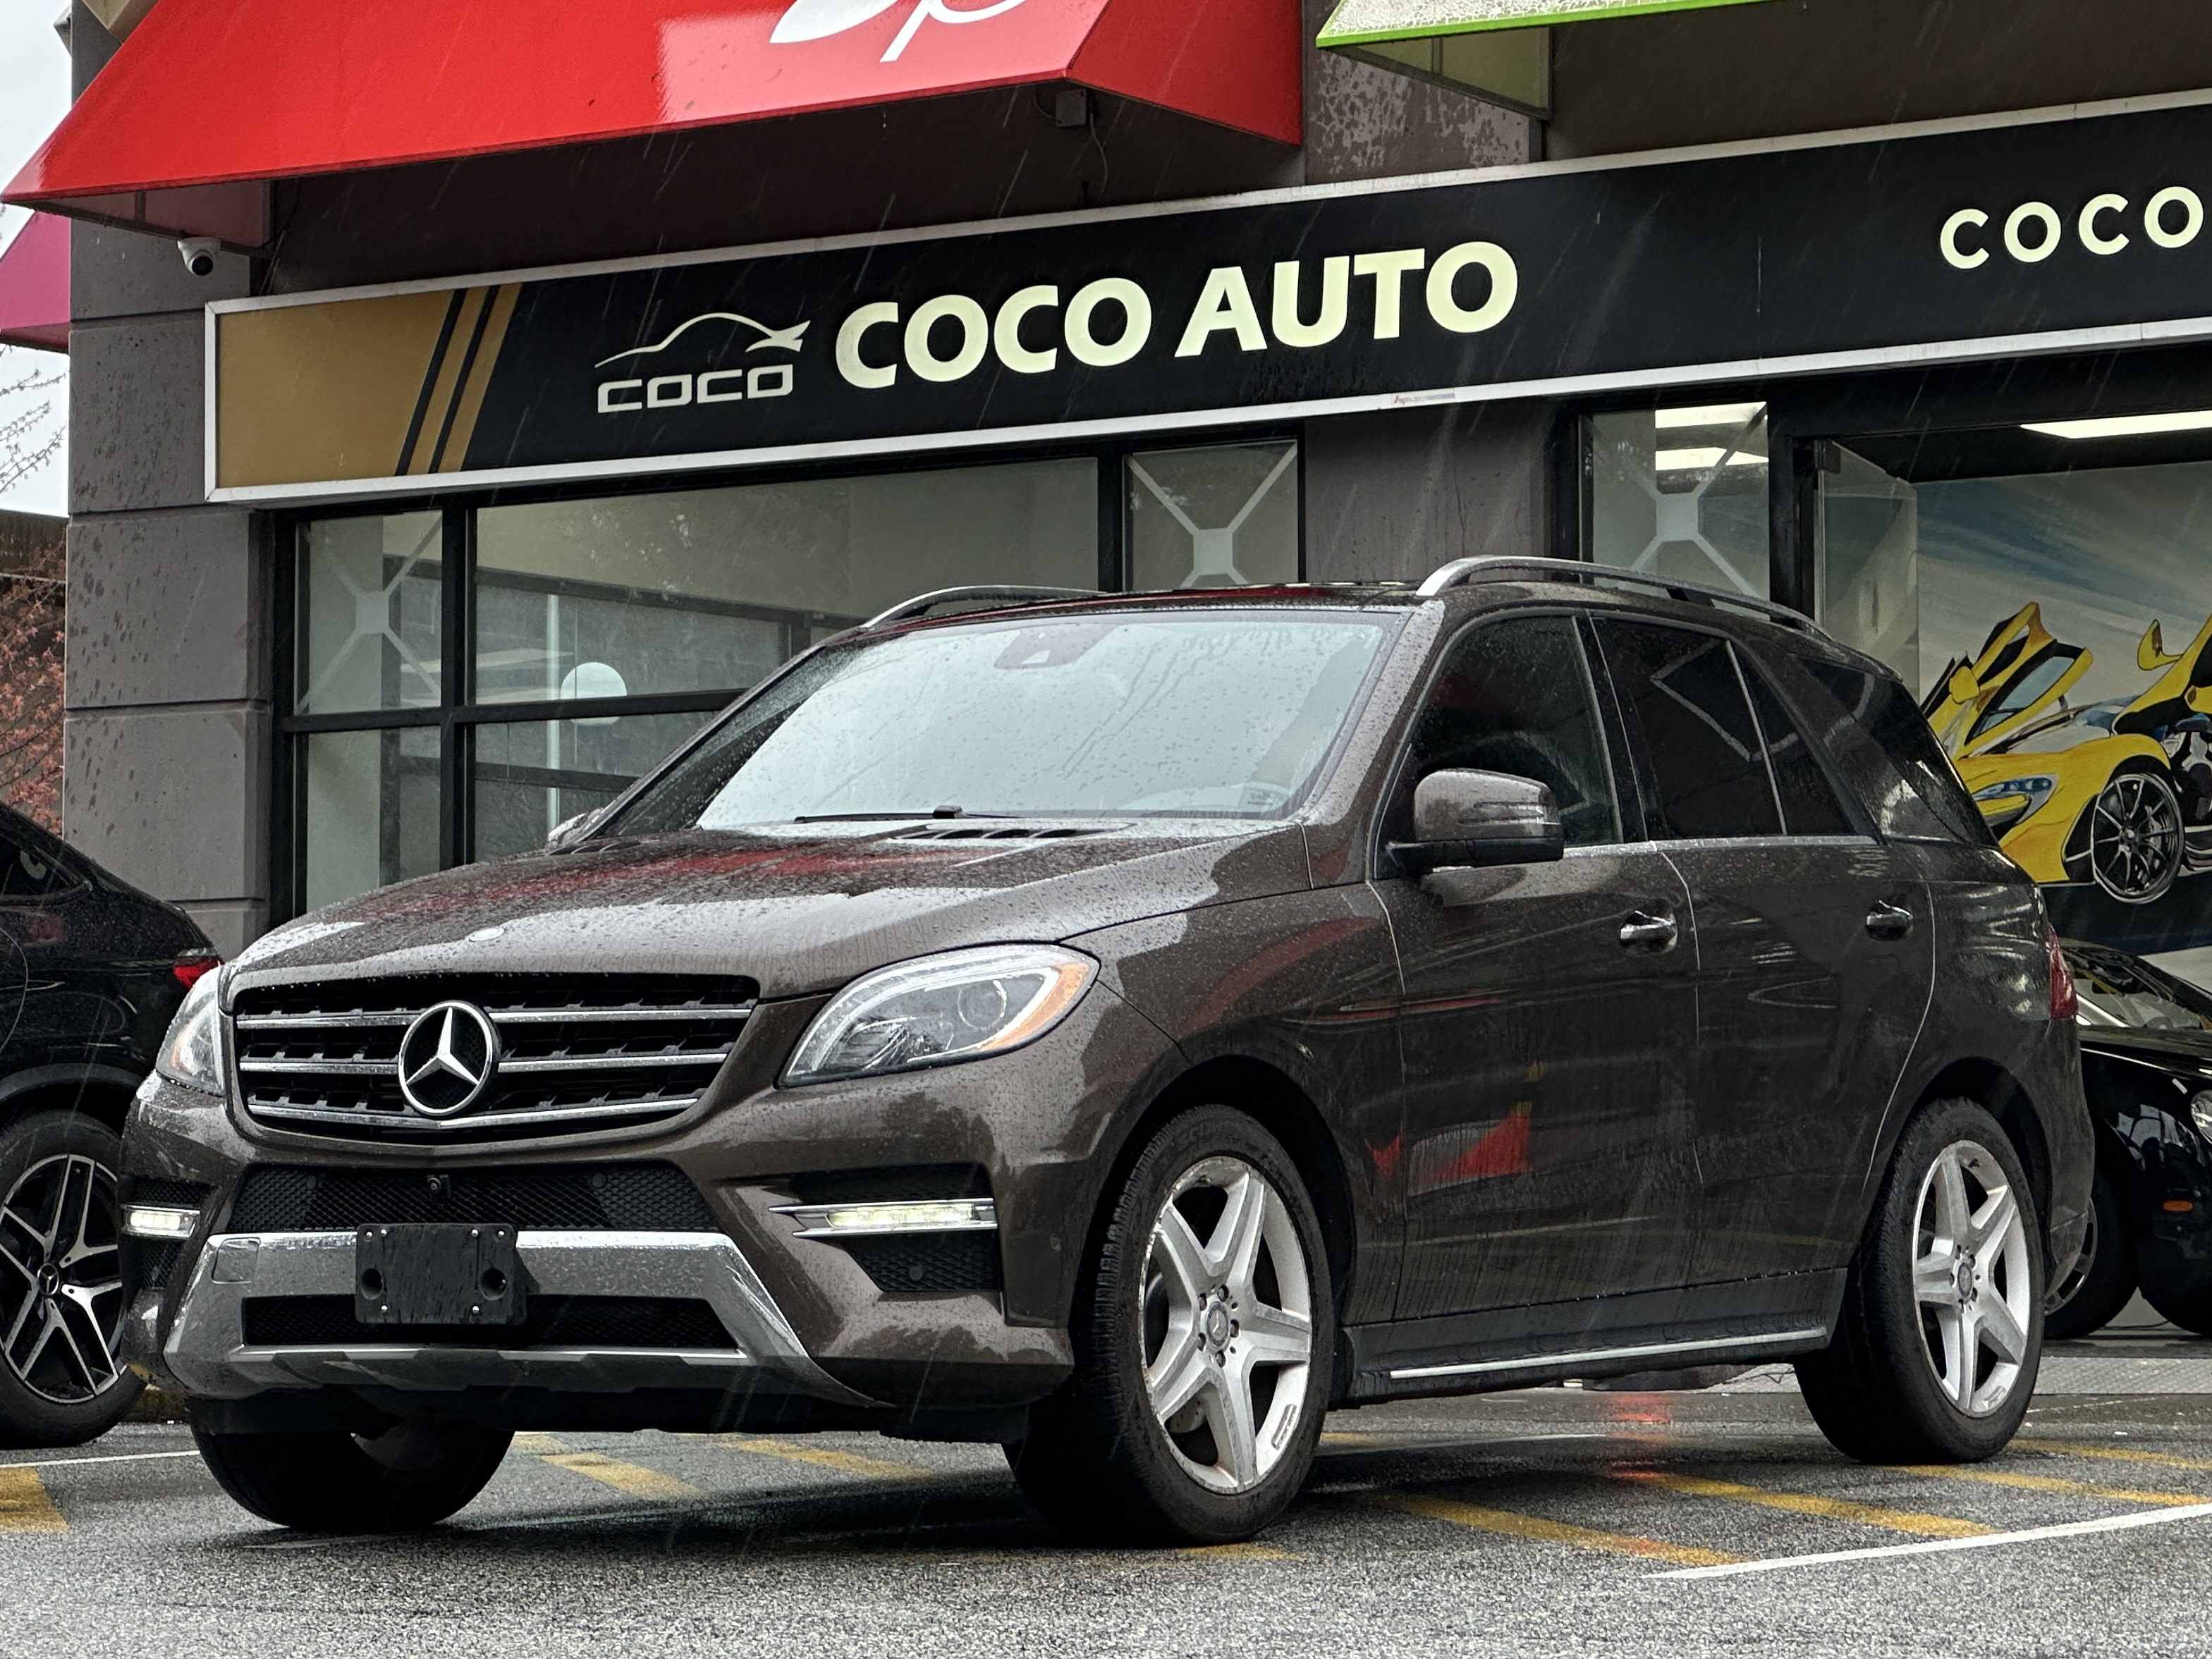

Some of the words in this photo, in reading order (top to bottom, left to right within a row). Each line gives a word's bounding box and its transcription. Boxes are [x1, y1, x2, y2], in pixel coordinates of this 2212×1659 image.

[1940, 186, 2204, 269] COCO
[836, 277, 1153, 389] COCO
[1174, 241, 1518, 357] AUTO
[597, 364, 794, 414] COCO
